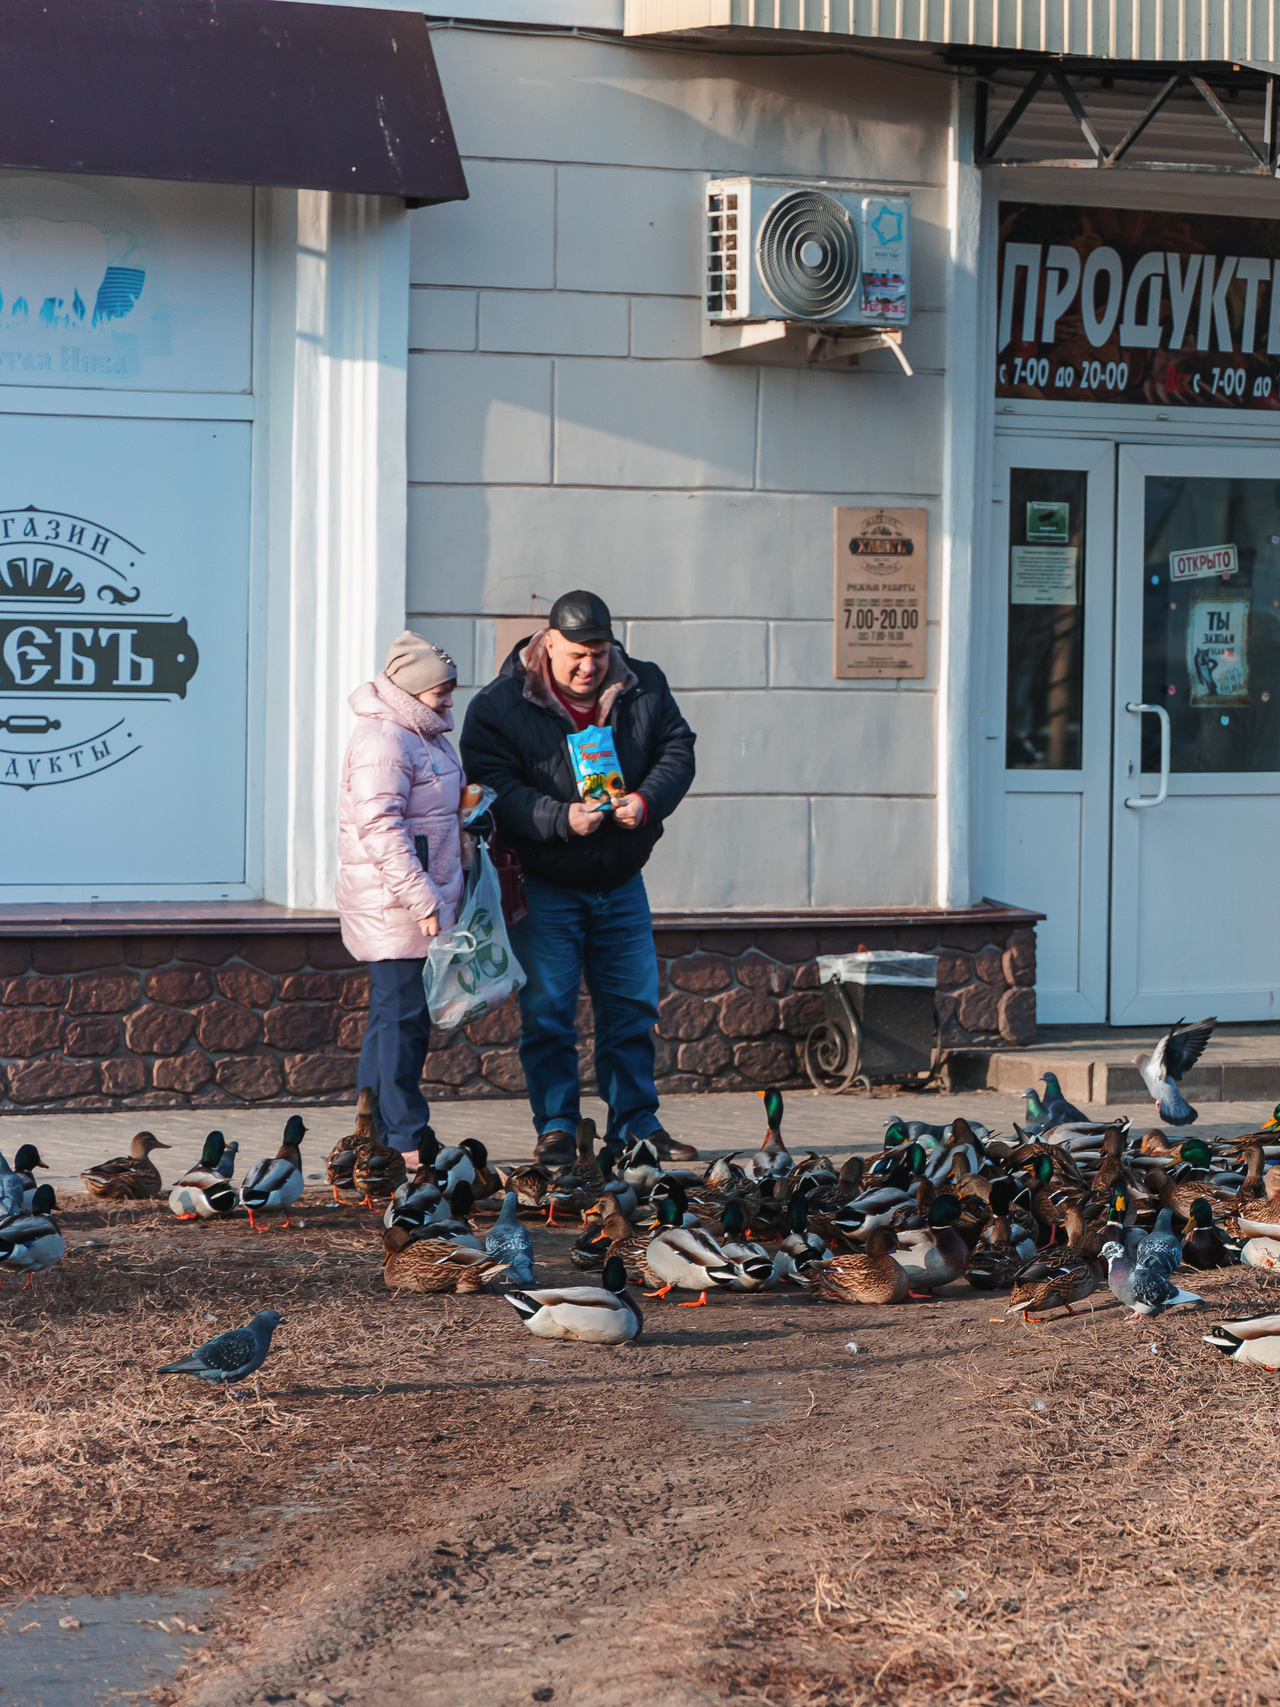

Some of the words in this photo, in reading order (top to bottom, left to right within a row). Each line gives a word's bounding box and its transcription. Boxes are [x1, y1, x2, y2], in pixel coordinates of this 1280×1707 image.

[1013, 357, 1050, 387] 7-00
[1055, 366, 1075, 388] до
[1080, 360, 1129, 391] 20-00
[1193, 373, 1201, 394] с
[1211, 367, 1247, 396] 7-00
[1253, 376, 1272, 397] до
[1177, 550, 1231, 574] ОТКРЫТО
[843, 608, 919, 629] 7.00-20.00
[1206, 611, 1230, 631] ТЫ
[0, 625, 154, 686] ЕБЪ
